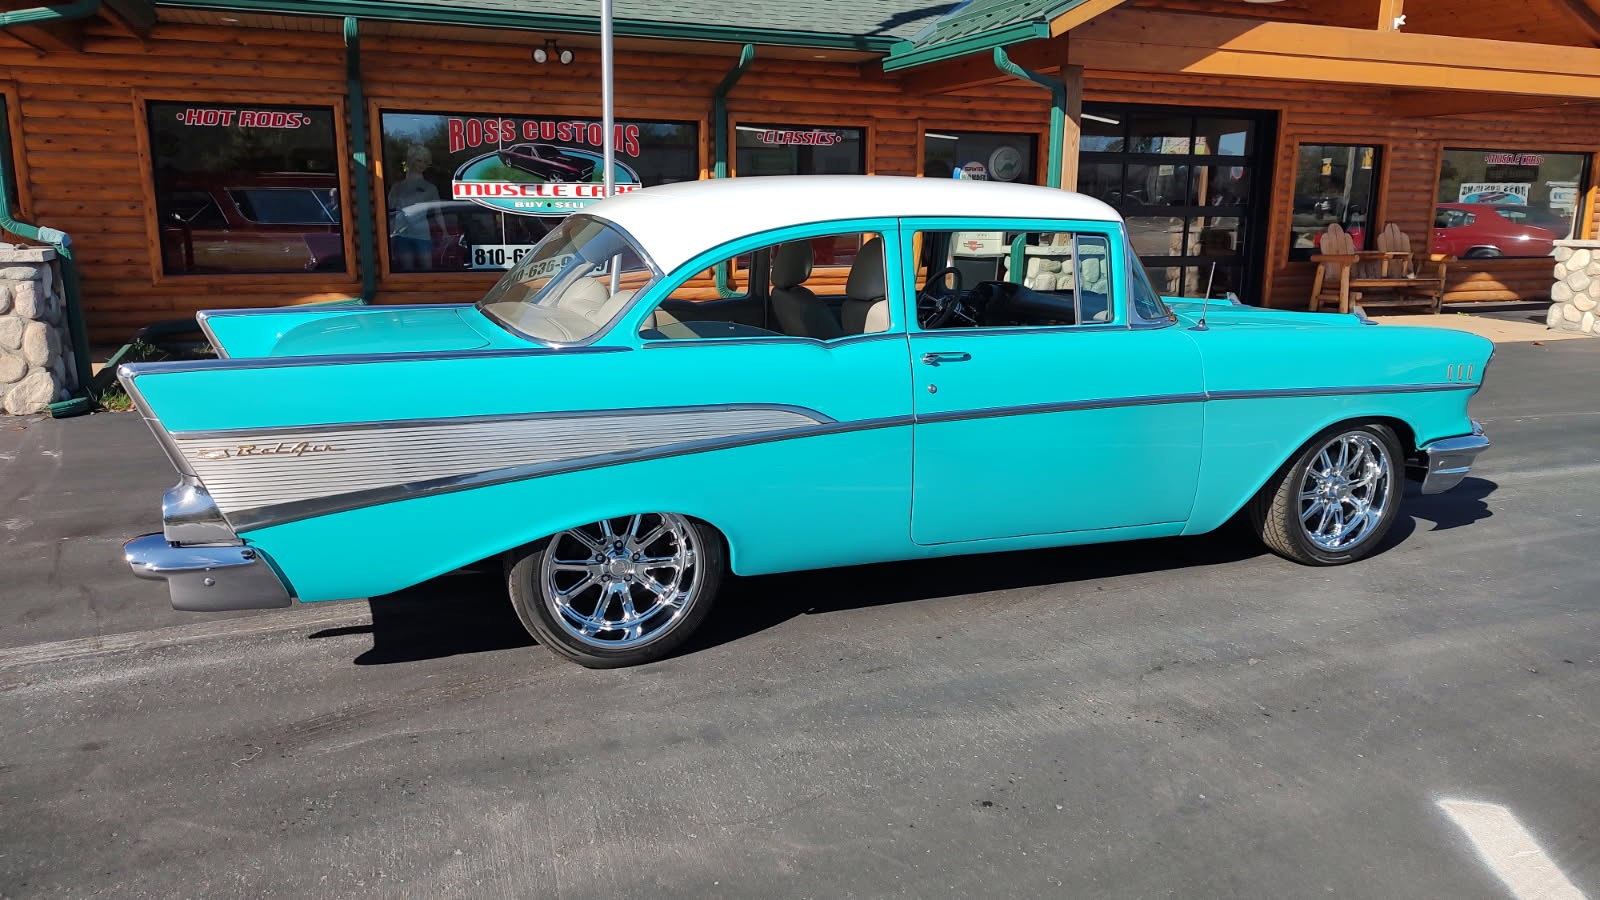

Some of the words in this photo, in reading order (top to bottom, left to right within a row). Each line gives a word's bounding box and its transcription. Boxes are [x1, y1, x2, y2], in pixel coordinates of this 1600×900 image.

[185, 109, 236, 126] HOT
[239, 111, 303, 128] RODS
[448, 118, 516, 154] ROSS
[763, 130, 836, 146] CLASSICS
[454, 183, 568, 197] MUSCLE
